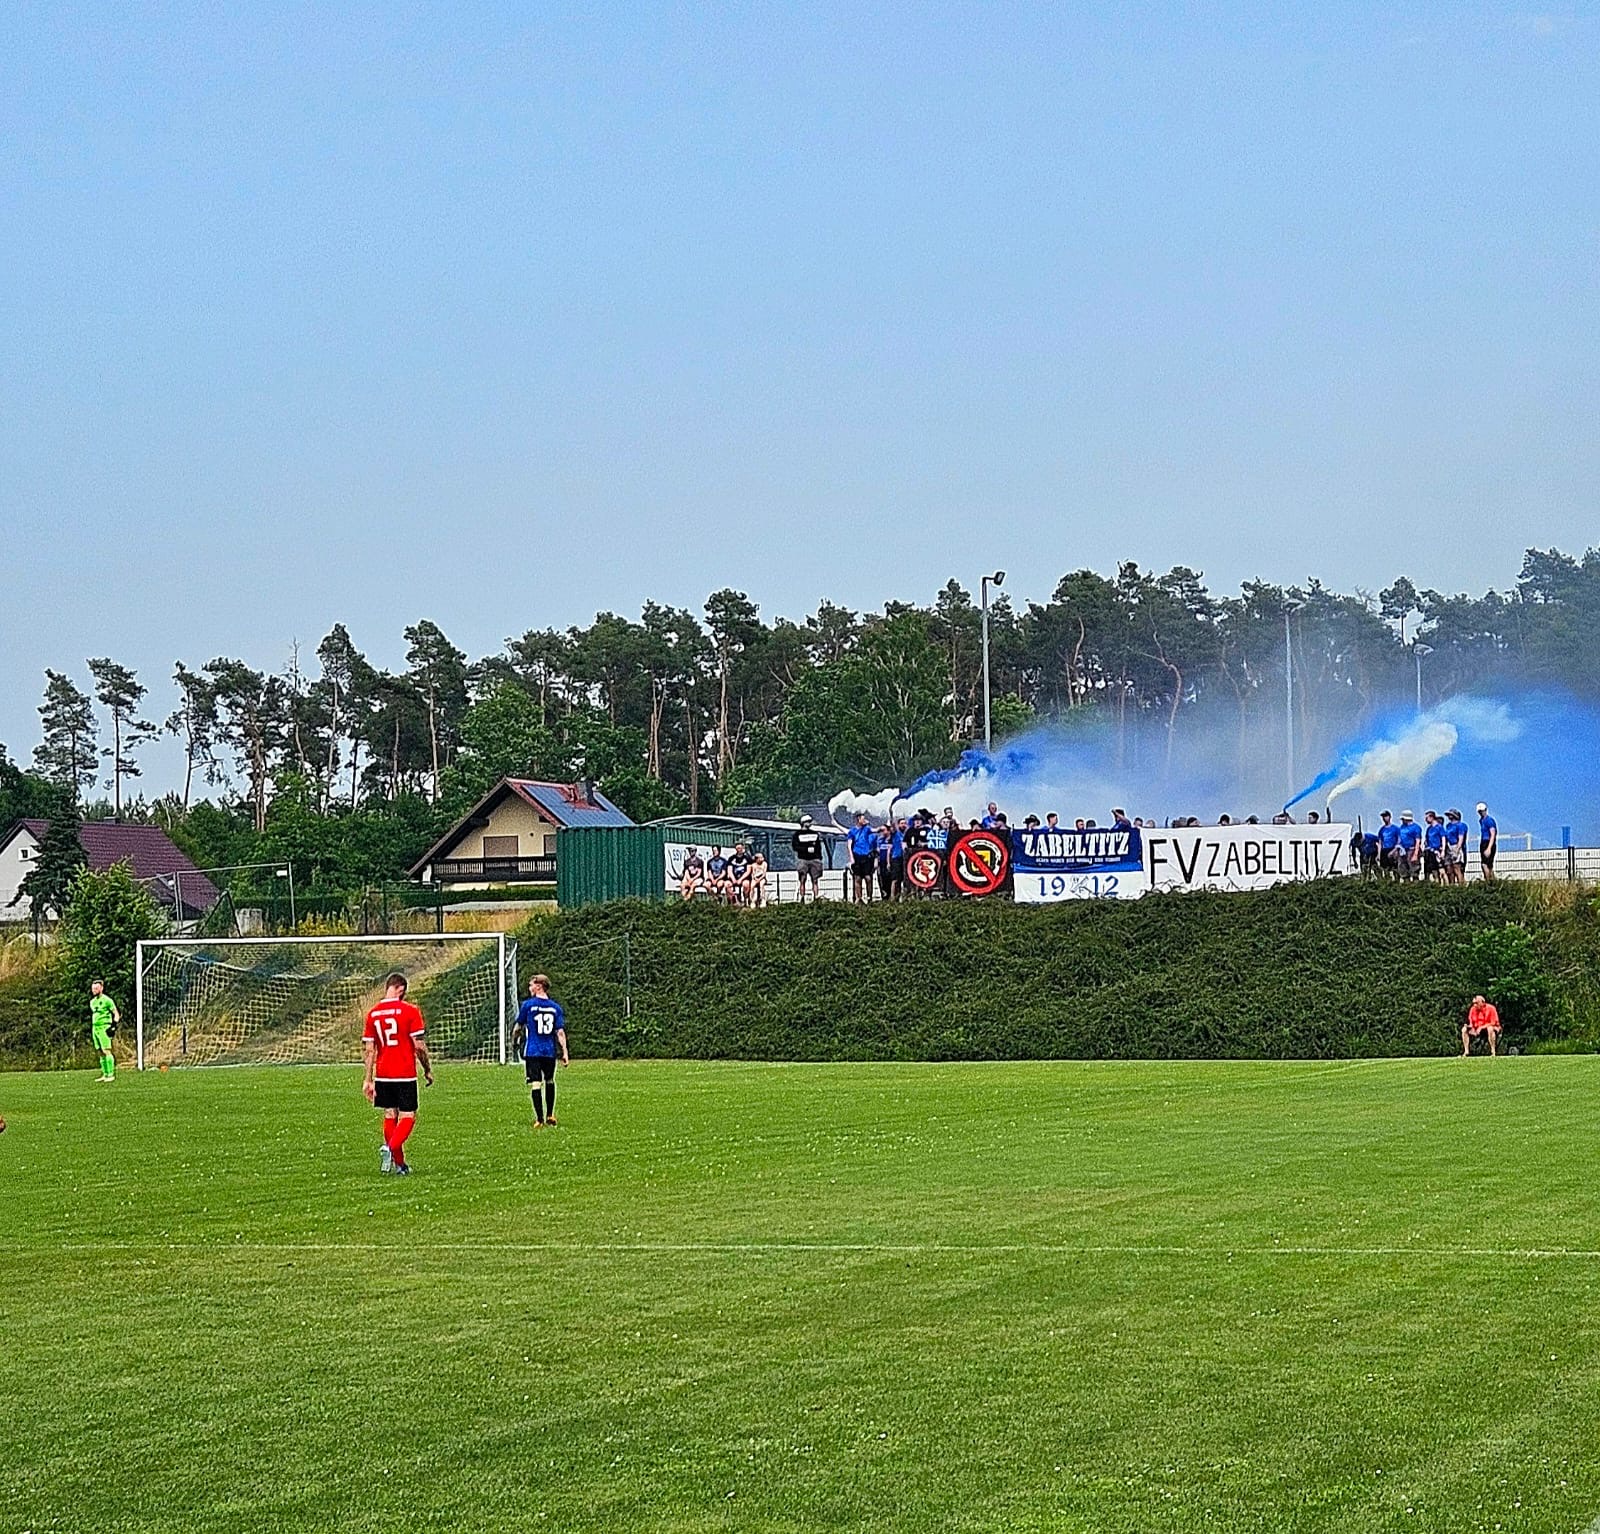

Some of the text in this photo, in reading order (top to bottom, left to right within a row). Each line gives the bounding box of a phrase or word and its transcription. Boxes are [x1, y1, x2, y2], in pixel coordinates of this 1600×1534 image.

[1021, 832, 1130, 857] ZABELTITZ
[1149, 838, 1343, 884] FV ZABELTITZ
[374, 1018, 398, 1048] 12
[534, 1013, 554, 1034] 13
